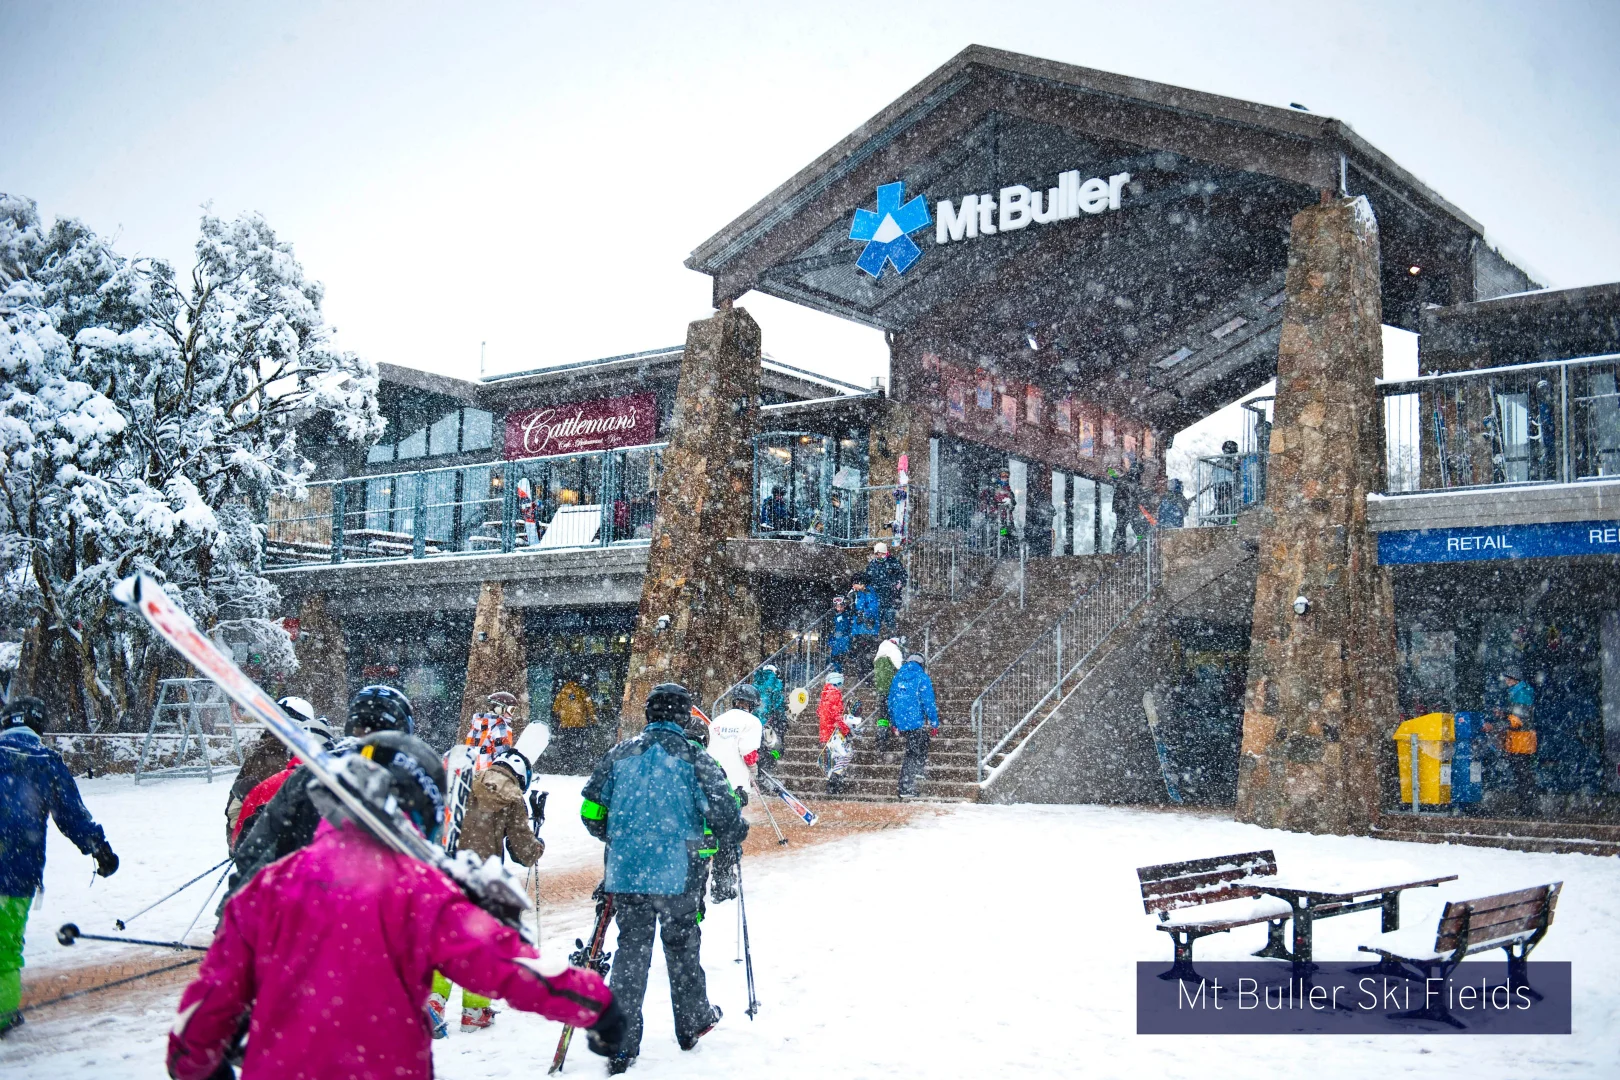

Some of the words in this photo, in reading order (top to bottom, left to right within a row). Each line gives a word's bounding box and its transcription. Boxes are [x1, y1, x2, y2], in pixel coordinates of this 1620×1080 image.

[521, 406, 636, 453] Cattleman's
[1447, 535, 1513, 551] RETAIL
[1589, 528, 1620, 544] RE
